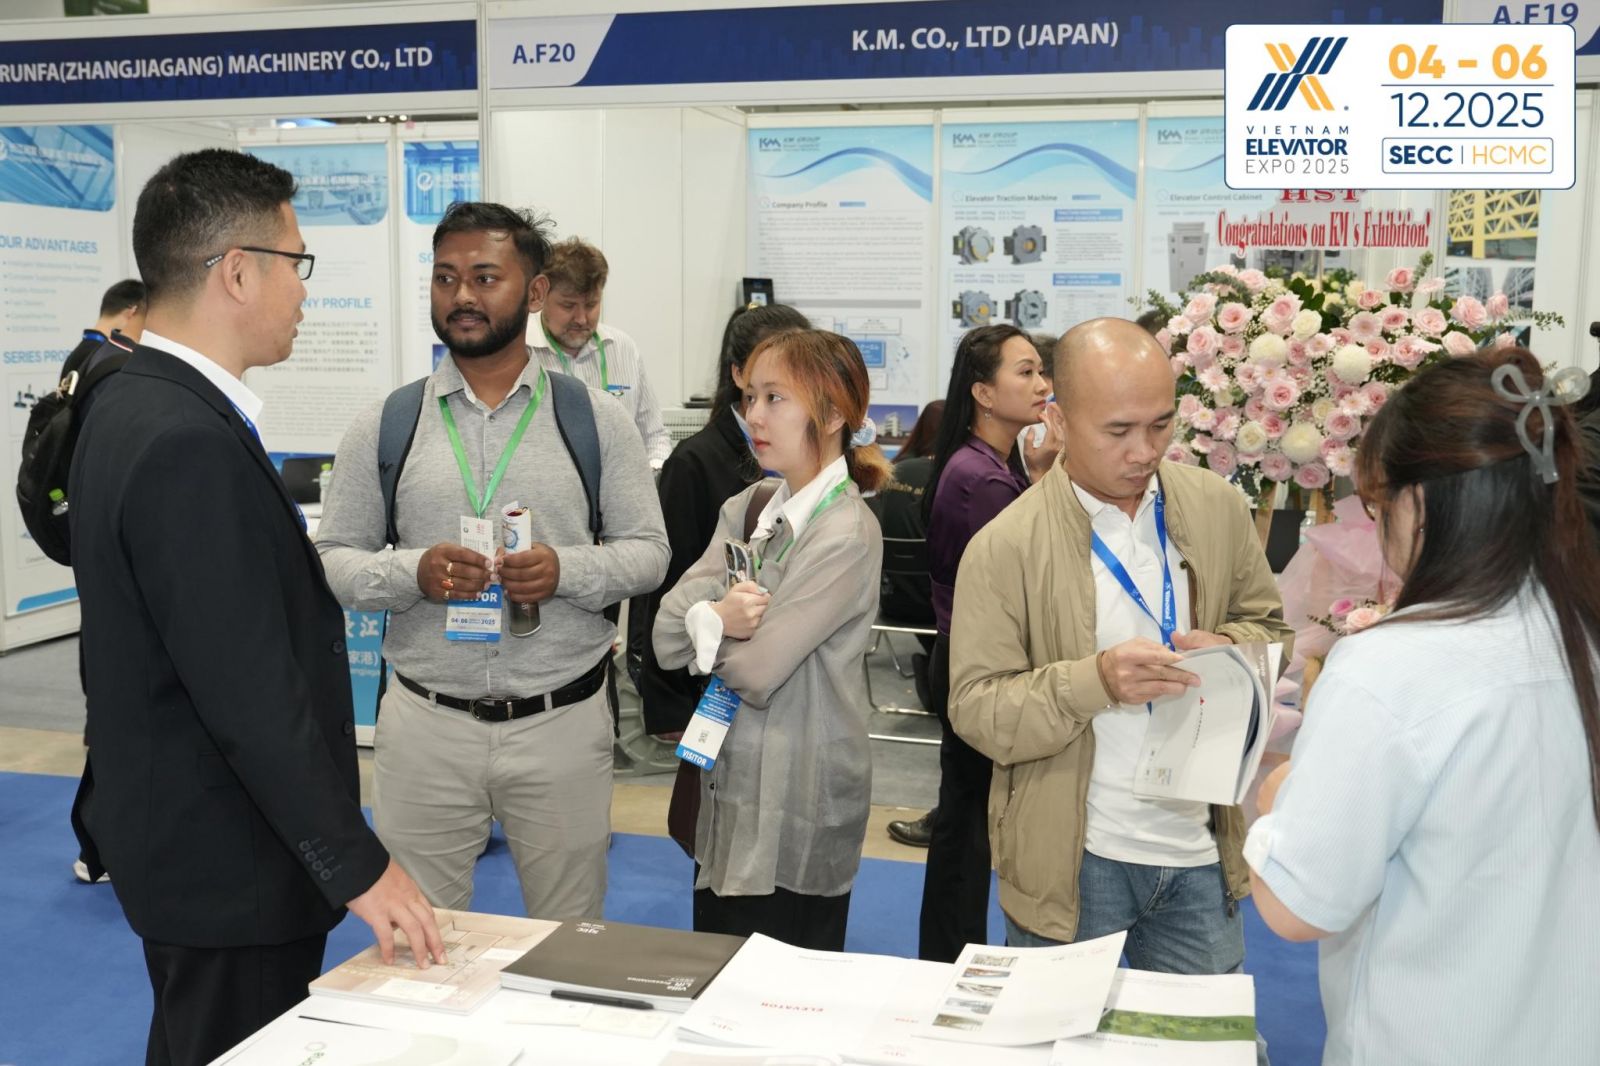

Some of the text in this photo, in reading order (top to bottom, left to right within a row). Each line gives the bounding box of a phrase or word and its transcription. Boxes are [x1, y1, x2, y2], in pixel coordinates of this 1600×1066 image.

[852, 22, 1119, 51] K.M. CO., LTD (JAPAN)
[228, 51, 345, 75] MACHINERY
[351, 49, 390, 71] CO.,
[395, 47, 433, 67] LTD
[512, 43, 576, 64] A.F20
[1218, 211, 1308, 254] Congratulations
[1311, 223, 1325, 247] on
[1363, 210, 1432, 249] Exhibition!
[25, 237, 98, 254] ADVANTAGES
[322, 297, 373, 309] PROFILE
[4, 351, 42, 364] SERIES
[682, 749, 707, 766] VISITOR
